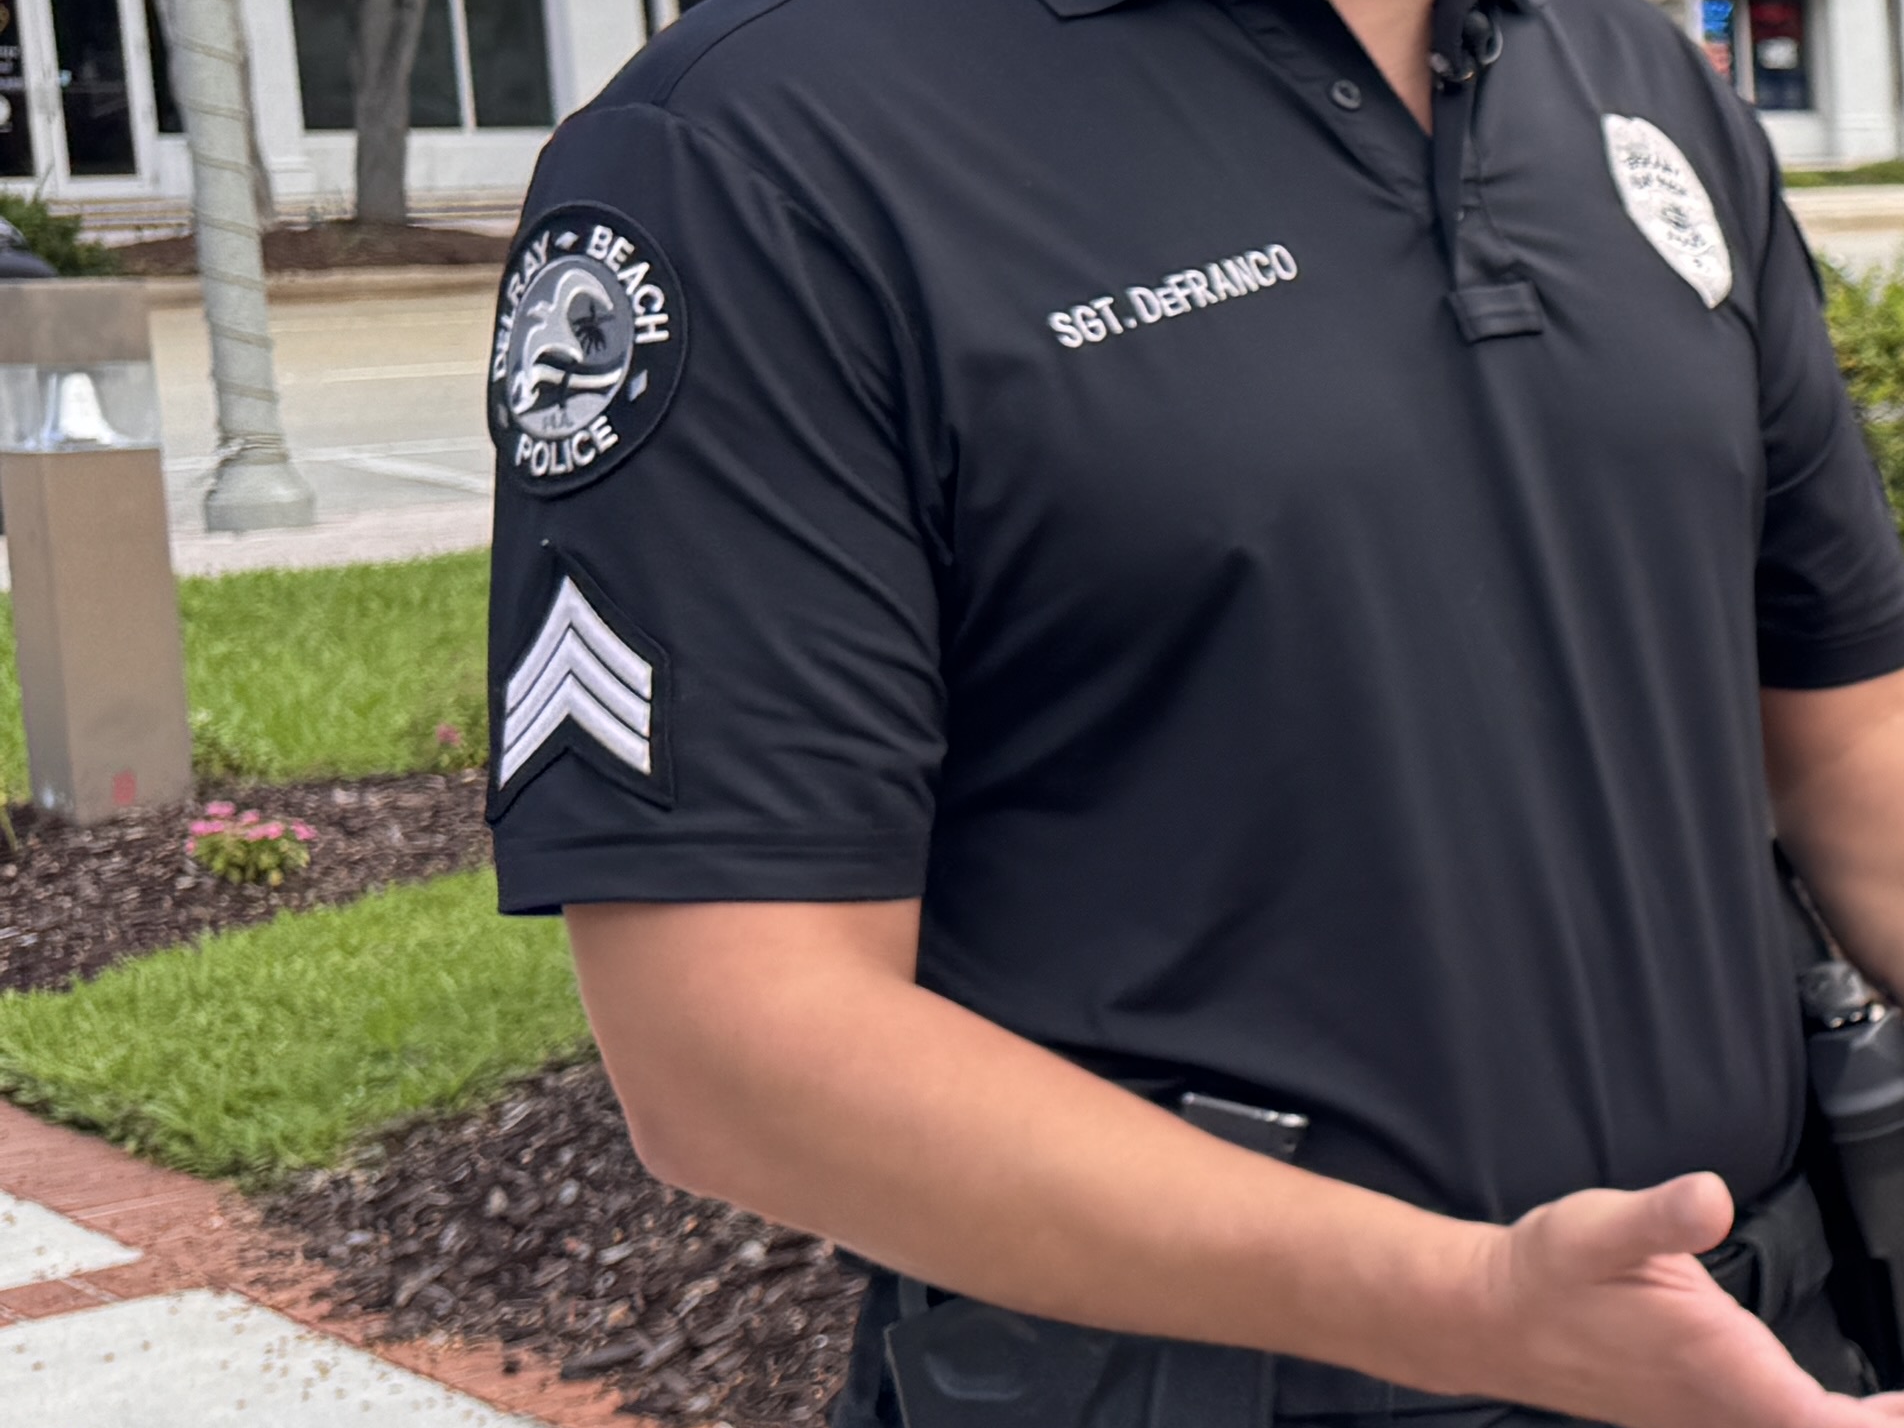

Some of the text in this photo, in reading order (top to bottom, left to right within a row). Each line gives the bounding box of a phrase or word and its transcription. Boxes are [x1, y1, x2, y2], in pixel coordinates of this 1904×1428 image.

[492, 224, 670, 382] DELRAY BEACH
[1048, 295, 1139, 349] SGT.
[514, 414, 619, 477] POLICE
